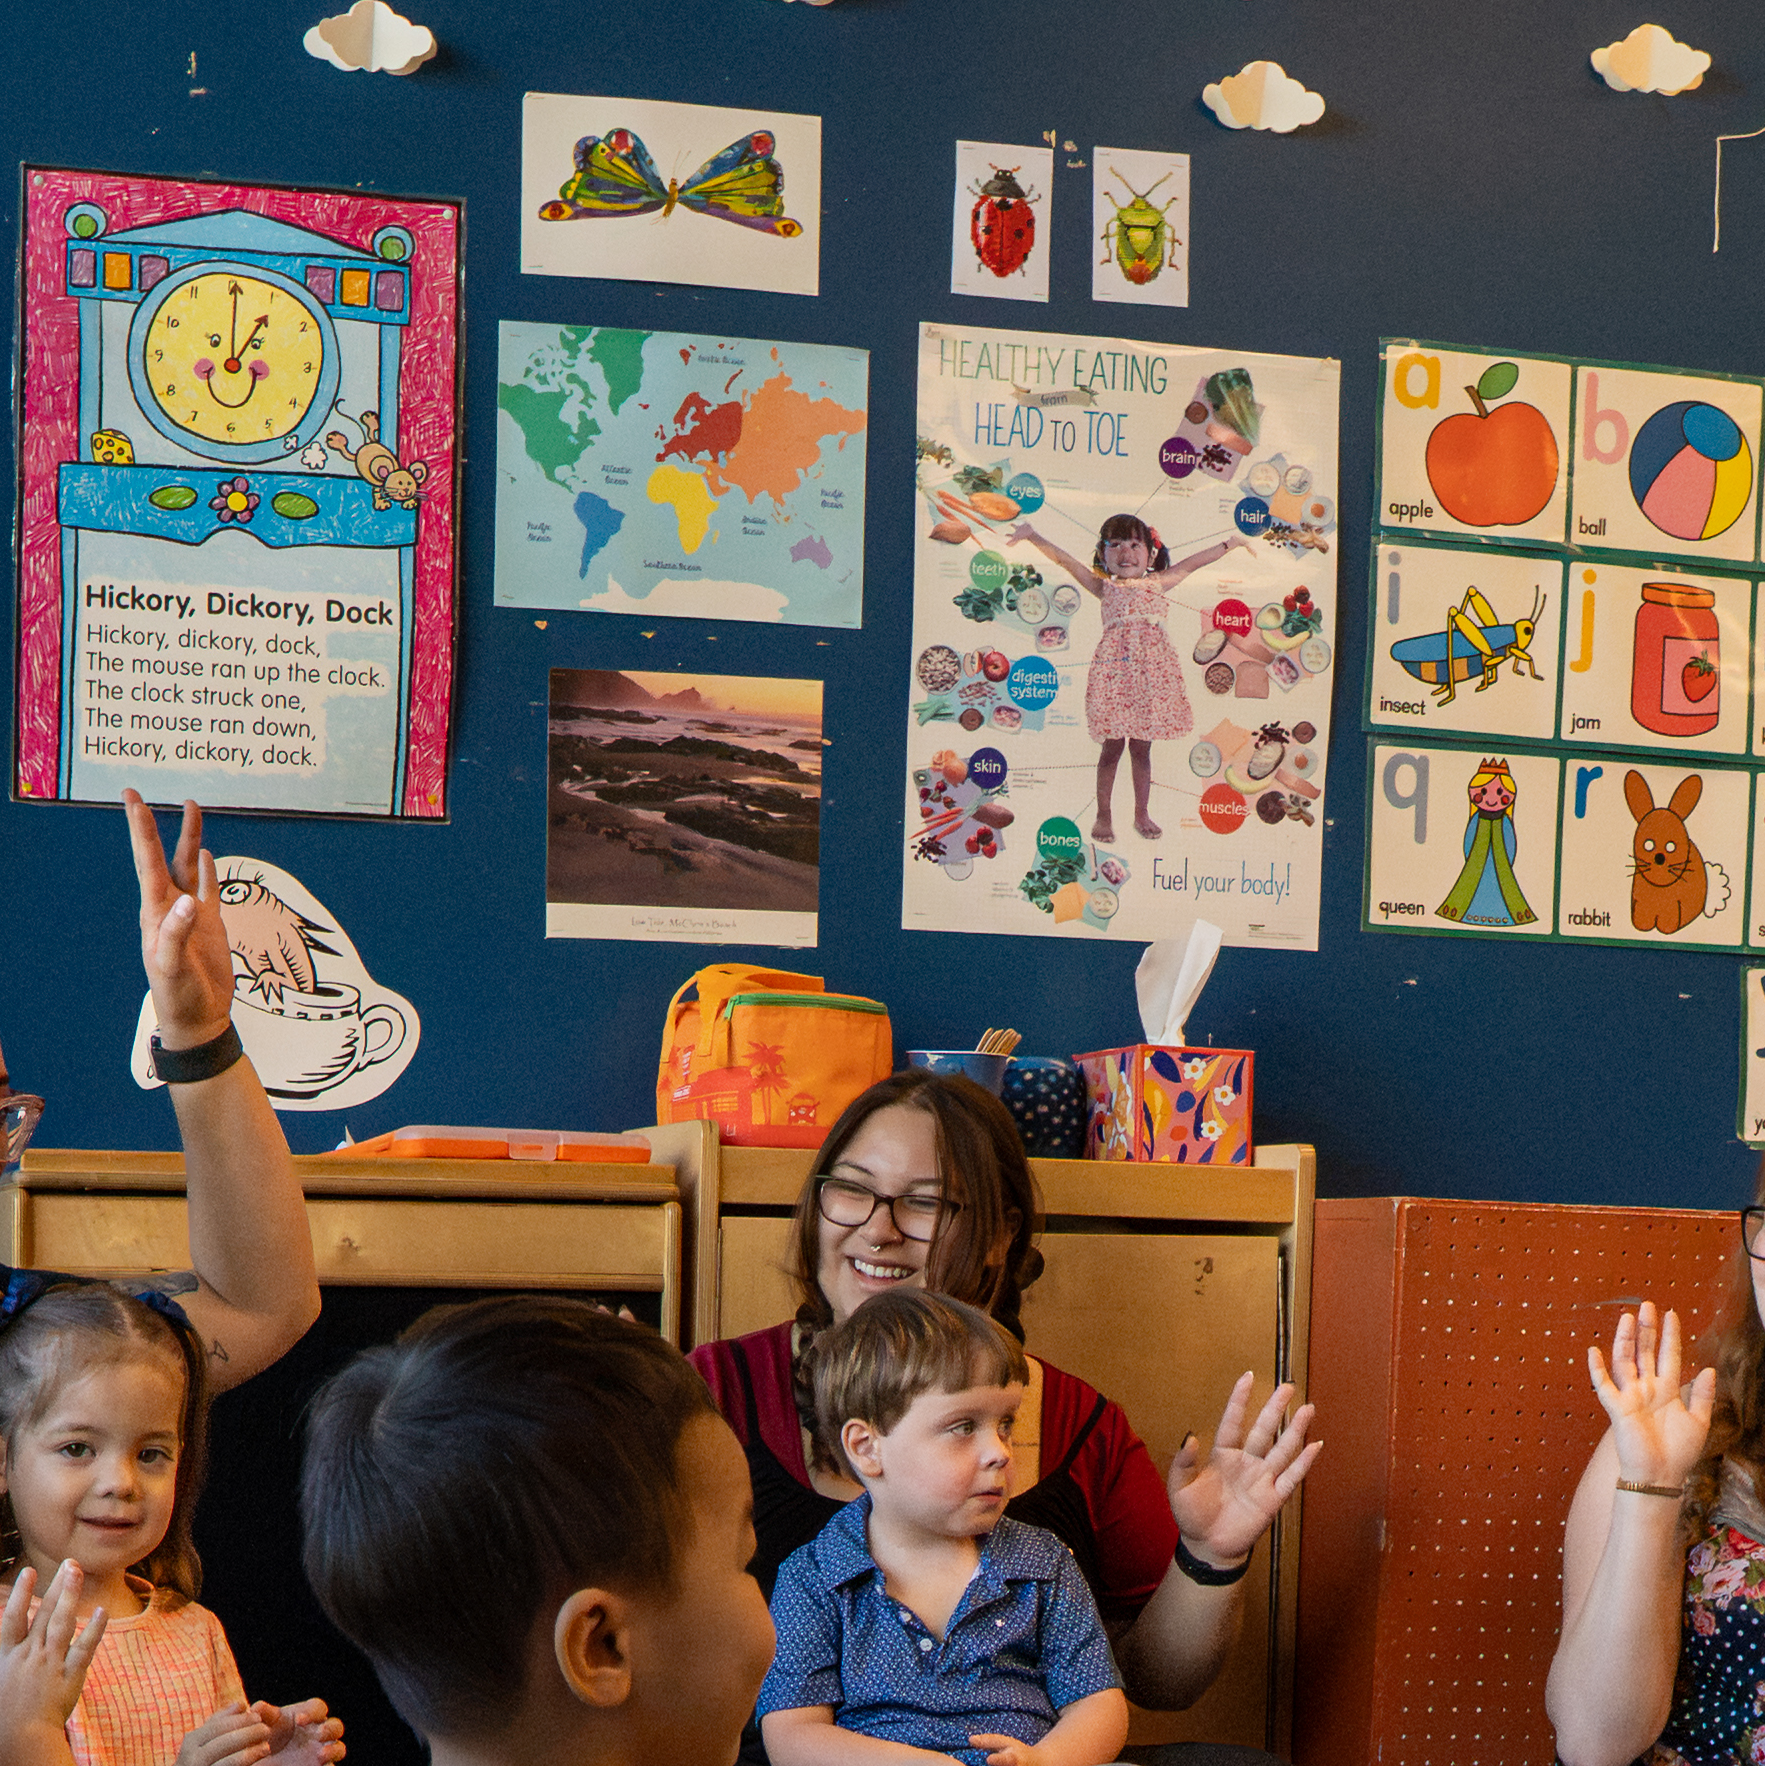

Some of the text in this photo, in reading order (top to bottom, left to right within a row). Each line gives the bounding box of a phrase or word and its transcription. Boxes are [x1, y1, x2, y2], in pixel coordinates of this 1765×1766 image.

[189, 285, 199, 299] 11
[166, 315, 180, 329] 10
[299, 321, 308, 333] 2
[154, 349, 164, 362] 9
[303, 361, 312, 374] 3
[939, 339, 1168, 395] HEALTHY EATING
[166, 384, 176, 396] 8
[1393, 352, 1441, 410] a
[288, 397, 297, 410] 4
[1040, 394, 1068, 406] from
[190, 410, 199, 422] 7
[265, 418, 273, 429] 5
[1582, 371, 1630, 465] b
[226, 422, 236, 433] 6
[974, 402, 1044, 449] HEAD
[1083, 410, 1129, 457] TOE
[1162, 448, 1196, 465] brain
[1009, 483, 1042, 500] eyes
[1240, 508, 1266, 524] hair
[1389, 498, 1434, 523] apple
[1578, 515, 1607, 537] ball
[971, 561, 1008, 576] teeth
[1387, 551, 1402, 625] i
[85, 584, 393, 627] Hickory, Dickory, Dock
[1215, 612, 1250, 628] heart
[1569, 568, 1597, 673] j
[86, 623, 321, 659] Hickory, dickory, dock,
[86, 651, 385, 688] The mouse ran up the clock.
[85, 679, 307, 714] The clock struck one,
[1010, 686, 1058, 701] system
[1380, 696, 1427, 716] insect
[85, 707, 316, 741] The mouse ran down,
[1570, 712, 1602, 735] jam
[84, 735, 317, 768] Hickory, dickory, dock.
[973, 758, 1001, 774] skin
[1382, 752, 1430, 845] q
[1574, 765, 1603, 819] r
[1200, 801, 1251, 817] muscles
[1040, 831, 1081, 848] bones
[1153, 857, 1291, 906] Fuel your body!
[1379, 900, 1425, 919] queen
[1567, 908, 1611, 928] rabbit
